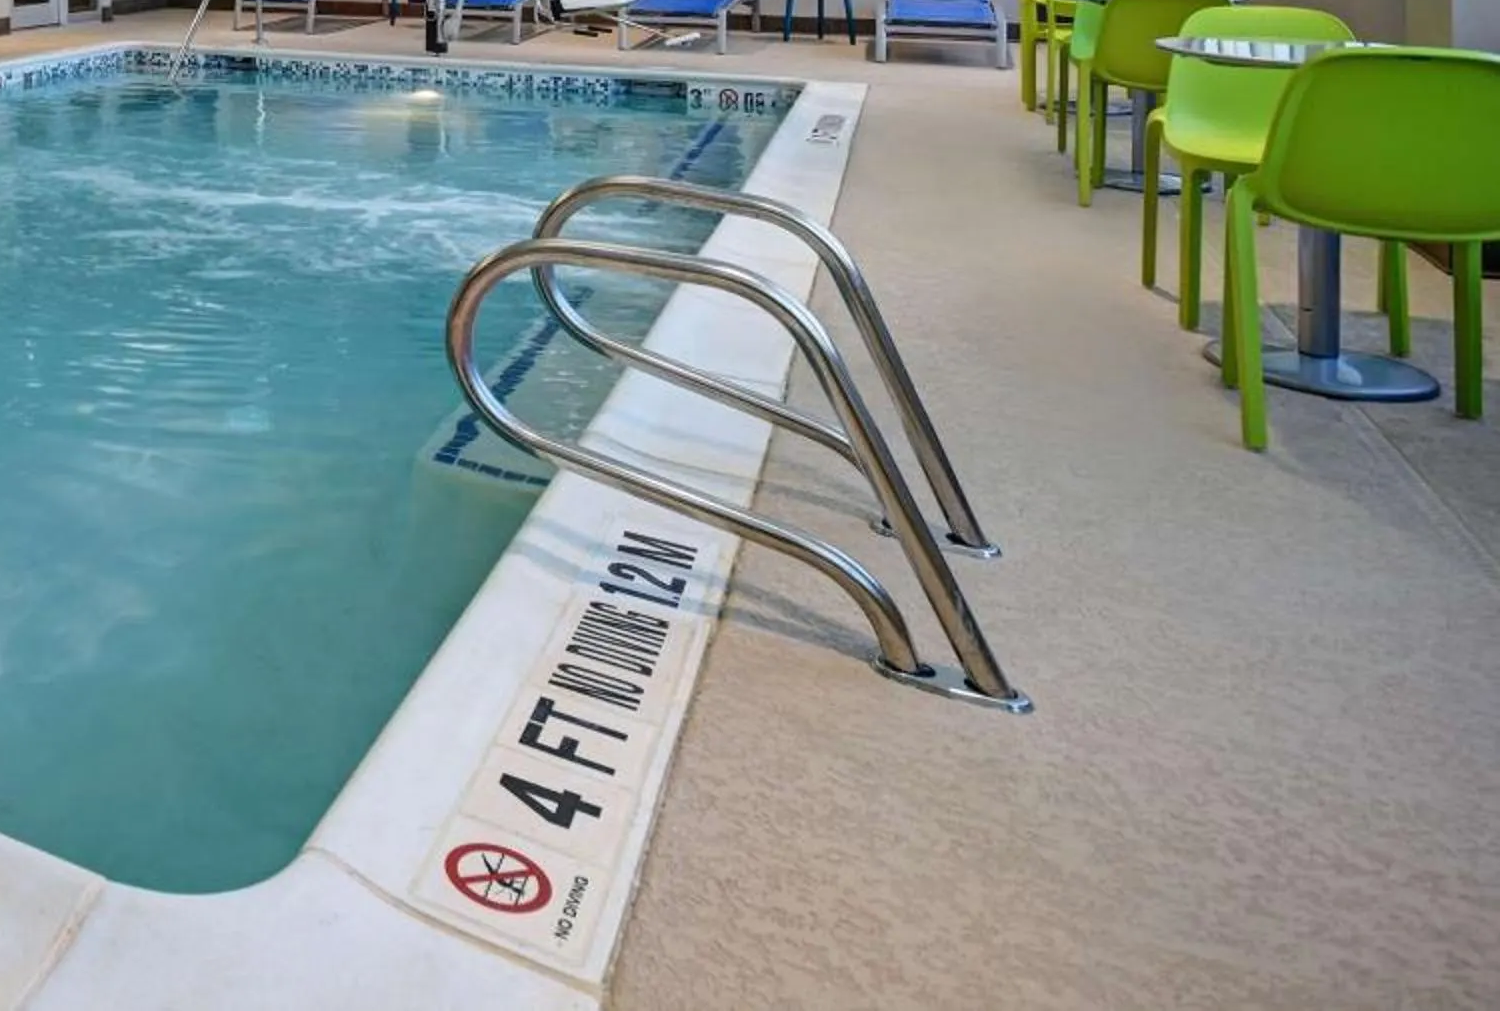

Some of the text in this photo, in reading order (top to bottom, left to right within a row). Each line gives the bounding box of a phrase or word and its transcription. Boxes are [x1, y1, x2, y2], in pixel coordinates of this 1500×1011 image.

[617, 530, 699, 570] M
[565, 601, 670, 677] DIVING
[548, 663, 644, 712] NO
[518, 696, 629, 776] FT
[499, 772, 603, 829] 4
[554, 875, 589, 942] NO DIVING
